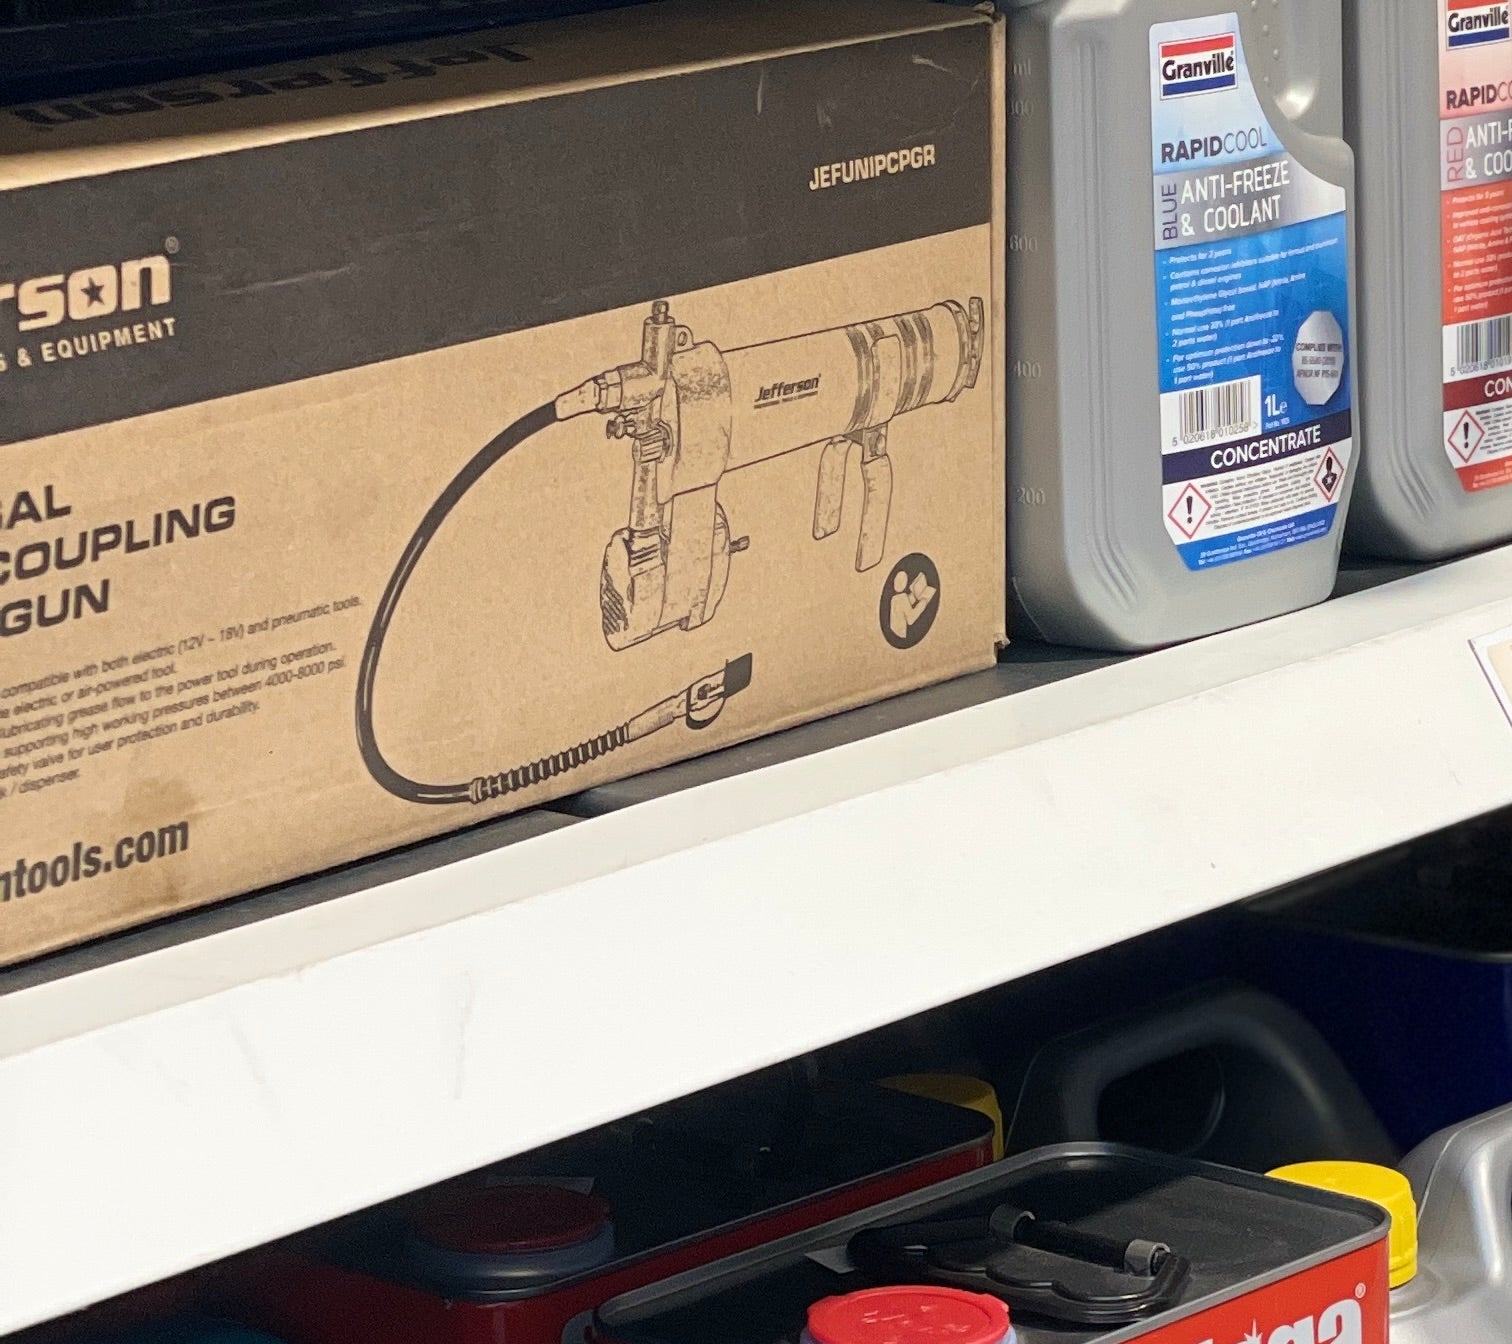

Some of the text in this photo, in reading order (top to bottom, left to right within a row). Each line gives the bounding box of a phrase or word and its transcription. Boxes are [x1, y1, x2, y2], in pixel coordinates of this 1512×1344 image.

[1448, 5, 1509, 32] Granville
[1161, 53, 1235, 83] Granville
[1161, 126, 1268, 164] RAPIDCOOL
[1447, 127, 1464, 182] RED
[809, 144, 936, 191] JEFUNIPCPGR
[1181, 160, 1290, 205] ANTI-FREEZE
[1465, 157, 1476, 179] &
[1161, 182, 1179, 242] BLUE
[1181, 195, 1281, 237] & COOLANT
[17, 317, 176, 367] & EQUIPMENT
[756, 373, 821, 401] Jefferson
[1210, 424, 1322, 469] CONCENTRATE
[0, 484, 72, 532] AL
[248, 618, 268, 635] and
[271, 604, 330, 631] pneumatic
[155, 683, 174, 698] the
[177, 674, 214, 695] power
[241, 655, 278, 677] during
[152, 693, 210, 719] pressures
[213, 679, 262, 703] between
